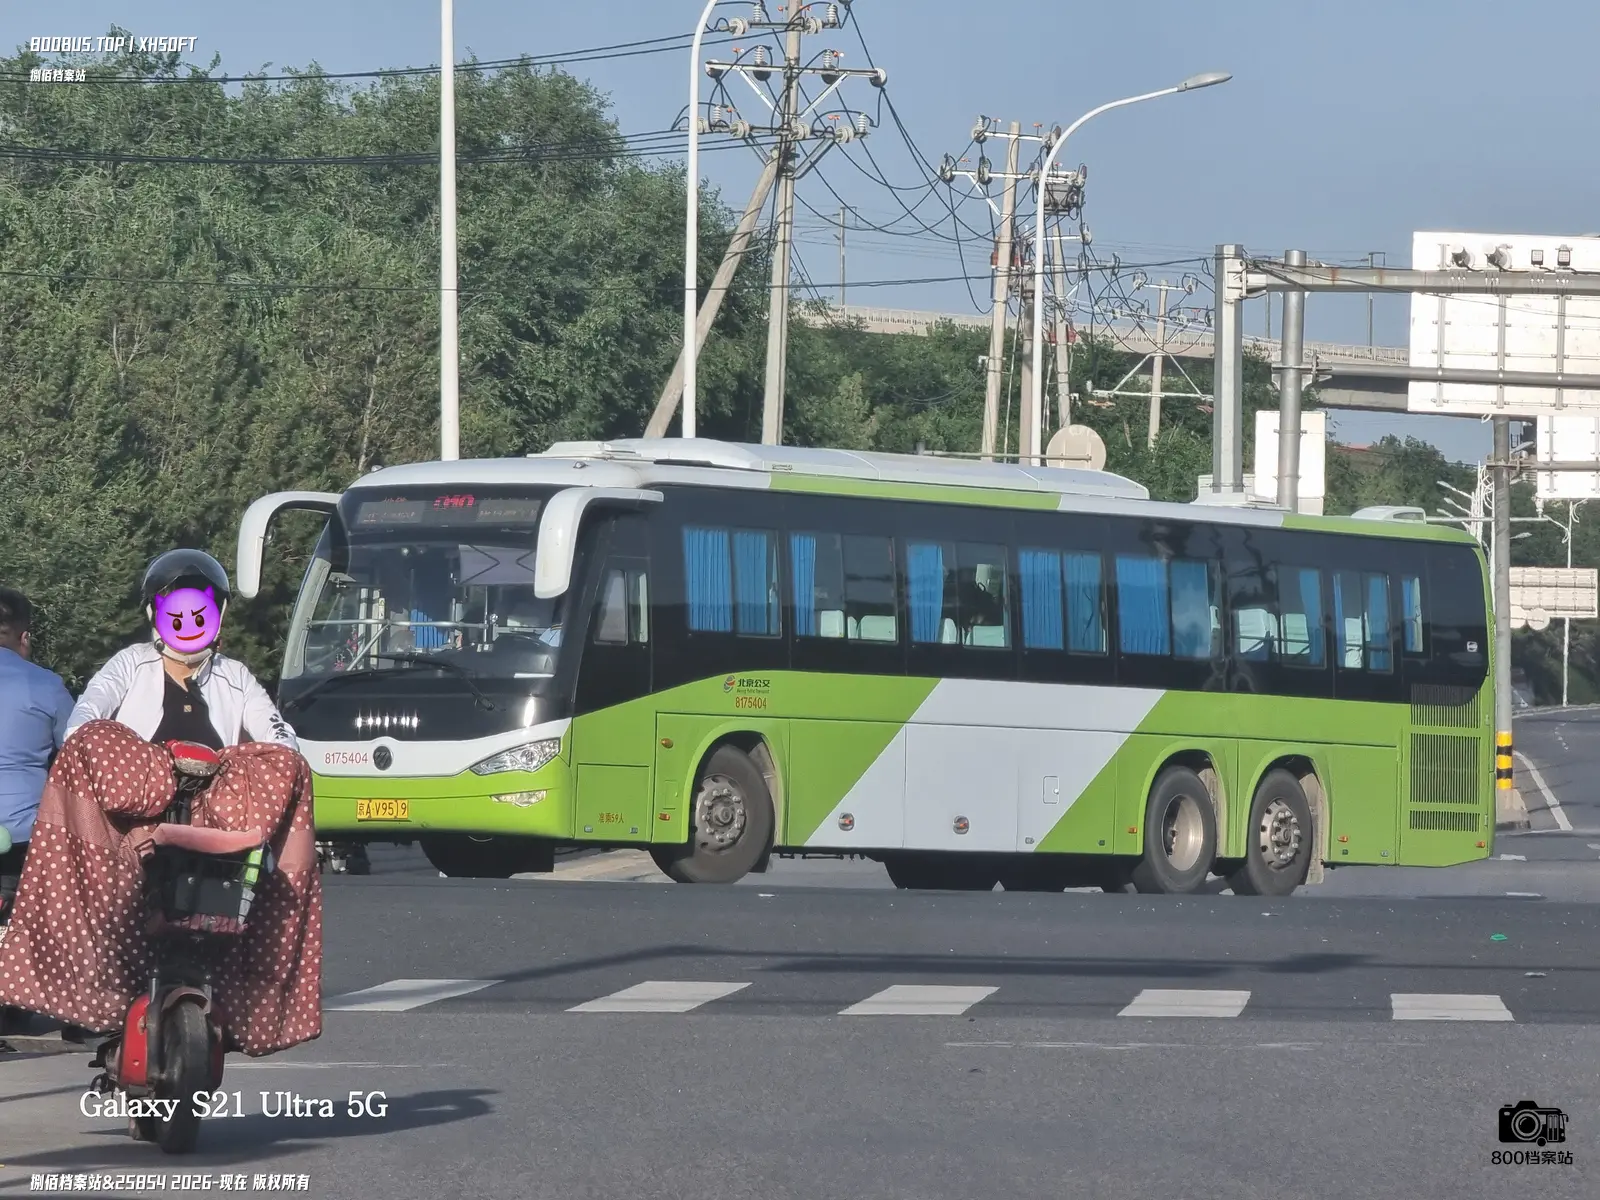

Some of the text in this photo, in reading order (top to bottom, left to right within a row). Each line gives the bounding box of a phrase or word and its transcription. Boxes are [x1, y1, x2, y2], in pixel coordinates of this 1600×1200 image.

[737, 678, 770, 688] 北京公交
[735, 696, 767, 709] 8175404
[324, 752, 368, 765] 8175404
